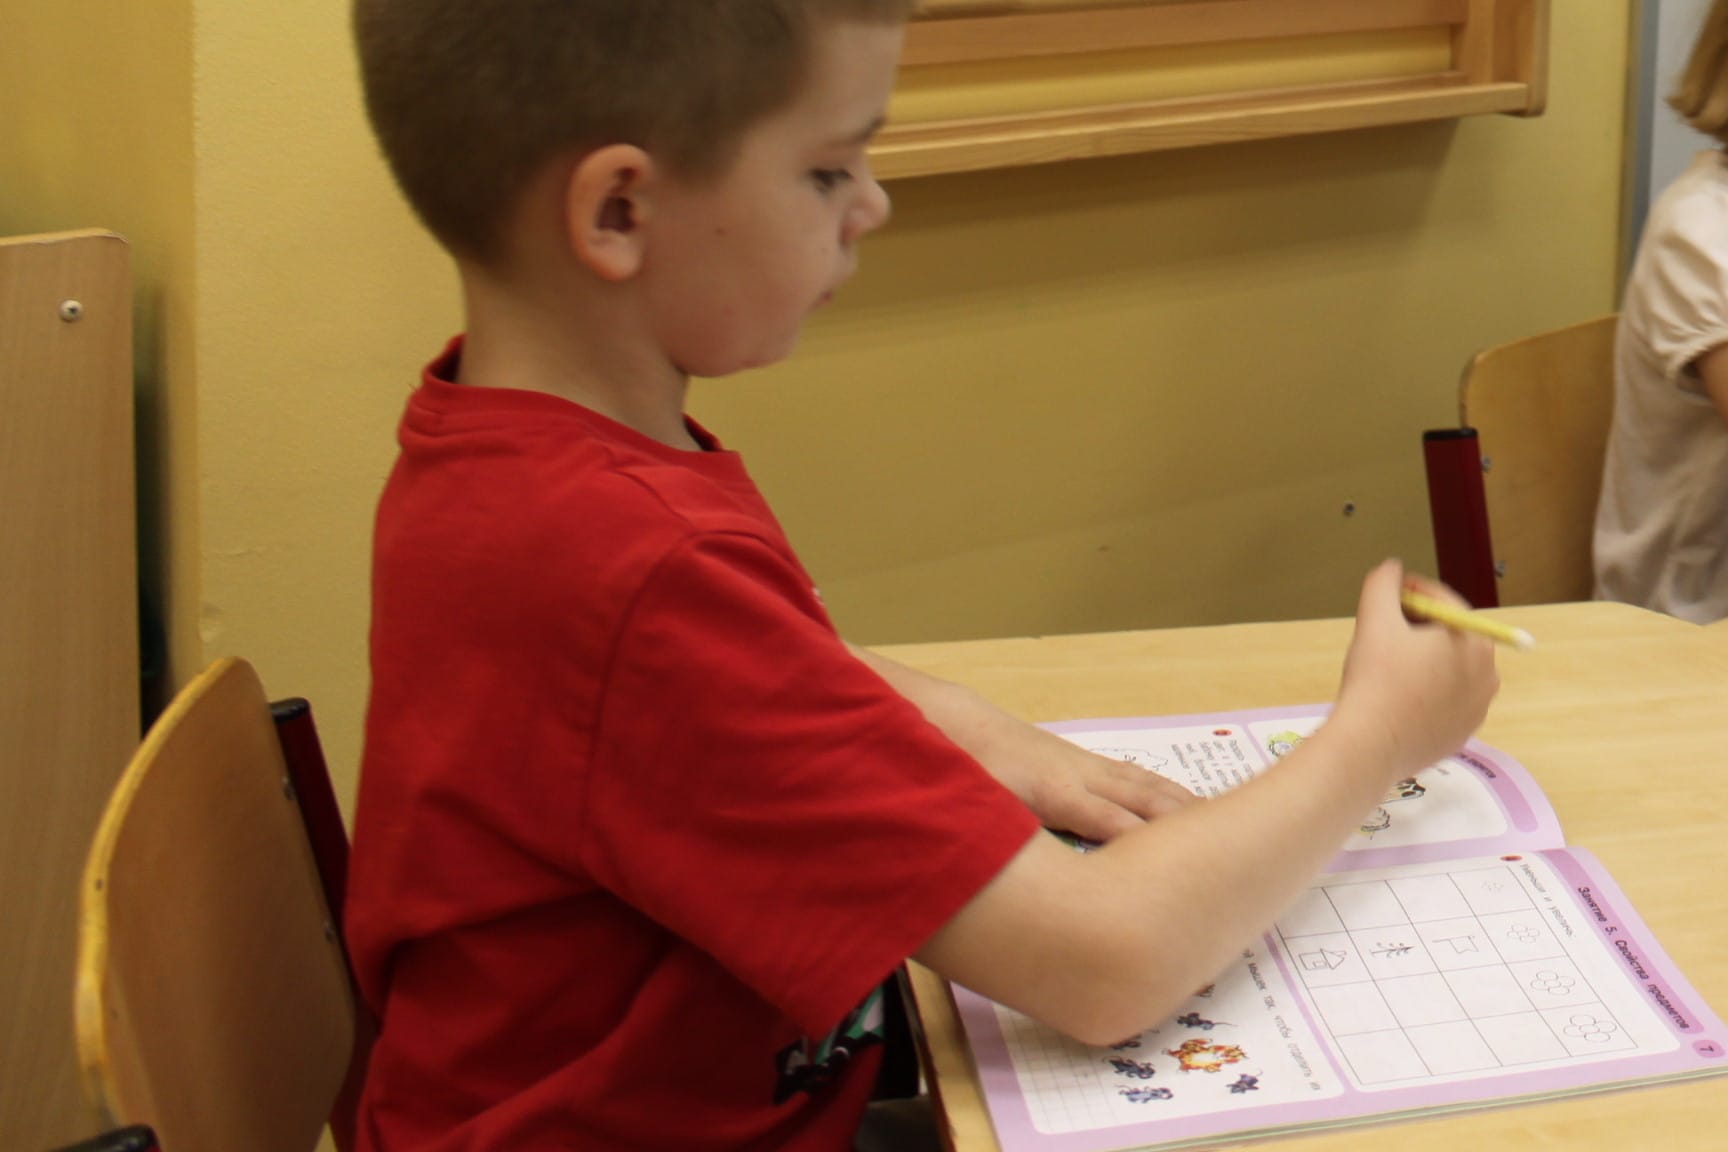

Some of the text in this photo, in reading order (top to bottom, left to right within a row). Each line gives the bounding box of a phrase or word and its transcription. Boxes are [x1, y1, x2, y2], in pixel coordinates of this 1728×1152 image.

[1577, 886, 1690, 1029] Занятие 5. Свойства предметов
